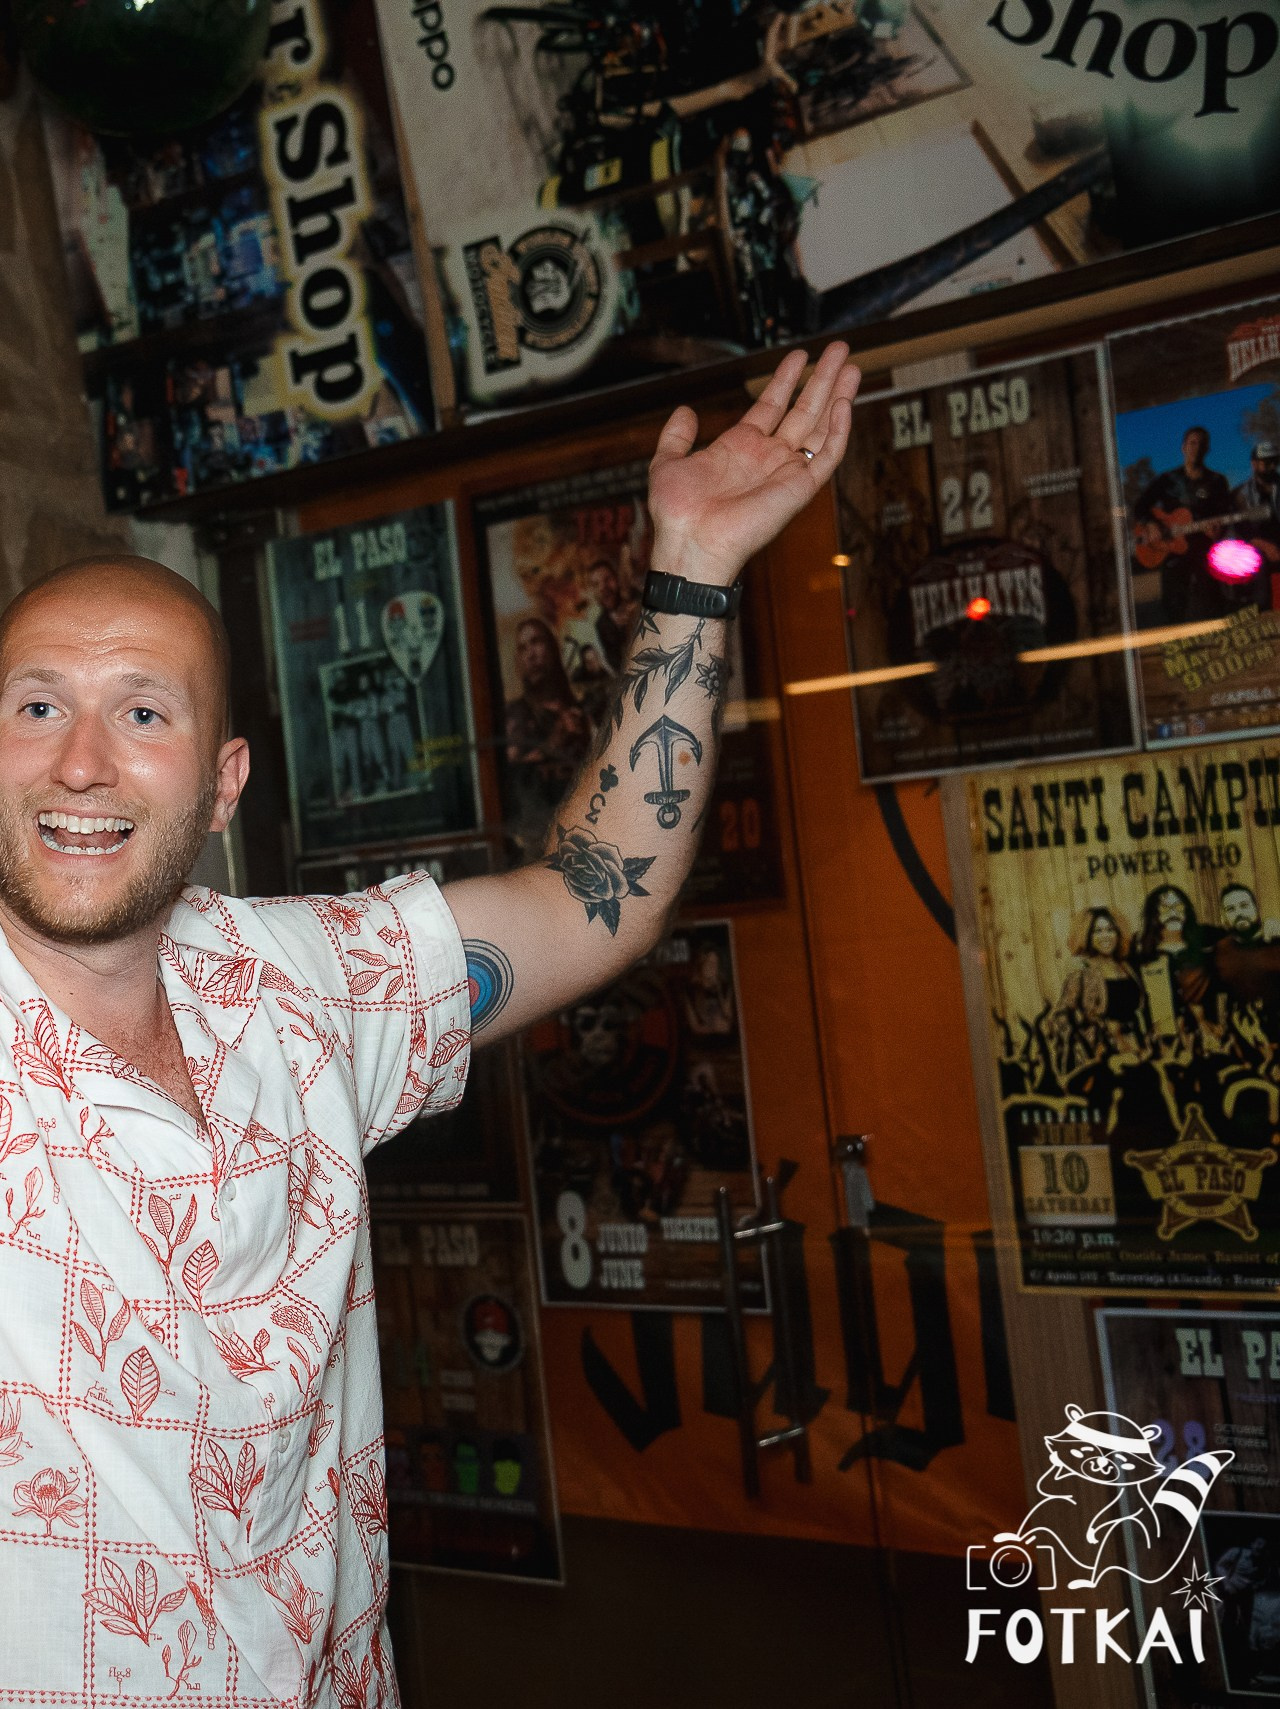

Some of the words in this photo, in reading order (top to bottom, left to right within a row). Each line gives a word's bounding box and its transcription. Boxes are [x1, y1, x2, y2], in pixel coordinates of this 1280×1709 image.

[412, 0, 454, 90] ppo
[276, 102, 364, 406] Shop
[890, 399, 932, 450] EL
[946, 376, 1031, 439] PASO
[940, 470, 995, 536] 22
[312, 538, 343, 582] EL
[350, 521, 408, 572] PASO
[334, 598, 371, 651] 11
[983, 775, 1110, 855] SANTI
[1086, 850, 1173, 880] POWER
[1039, 1151, 1090, 1194] 10
[1158, 1166, 1186, 1193] EL
[1195, 1164, 1246, 1193] PASO
[418, 1223, 480, 1268] PASO
[557, 1190, 594, 1290] 8
[1174, 1327, 1226, 1378] EL
